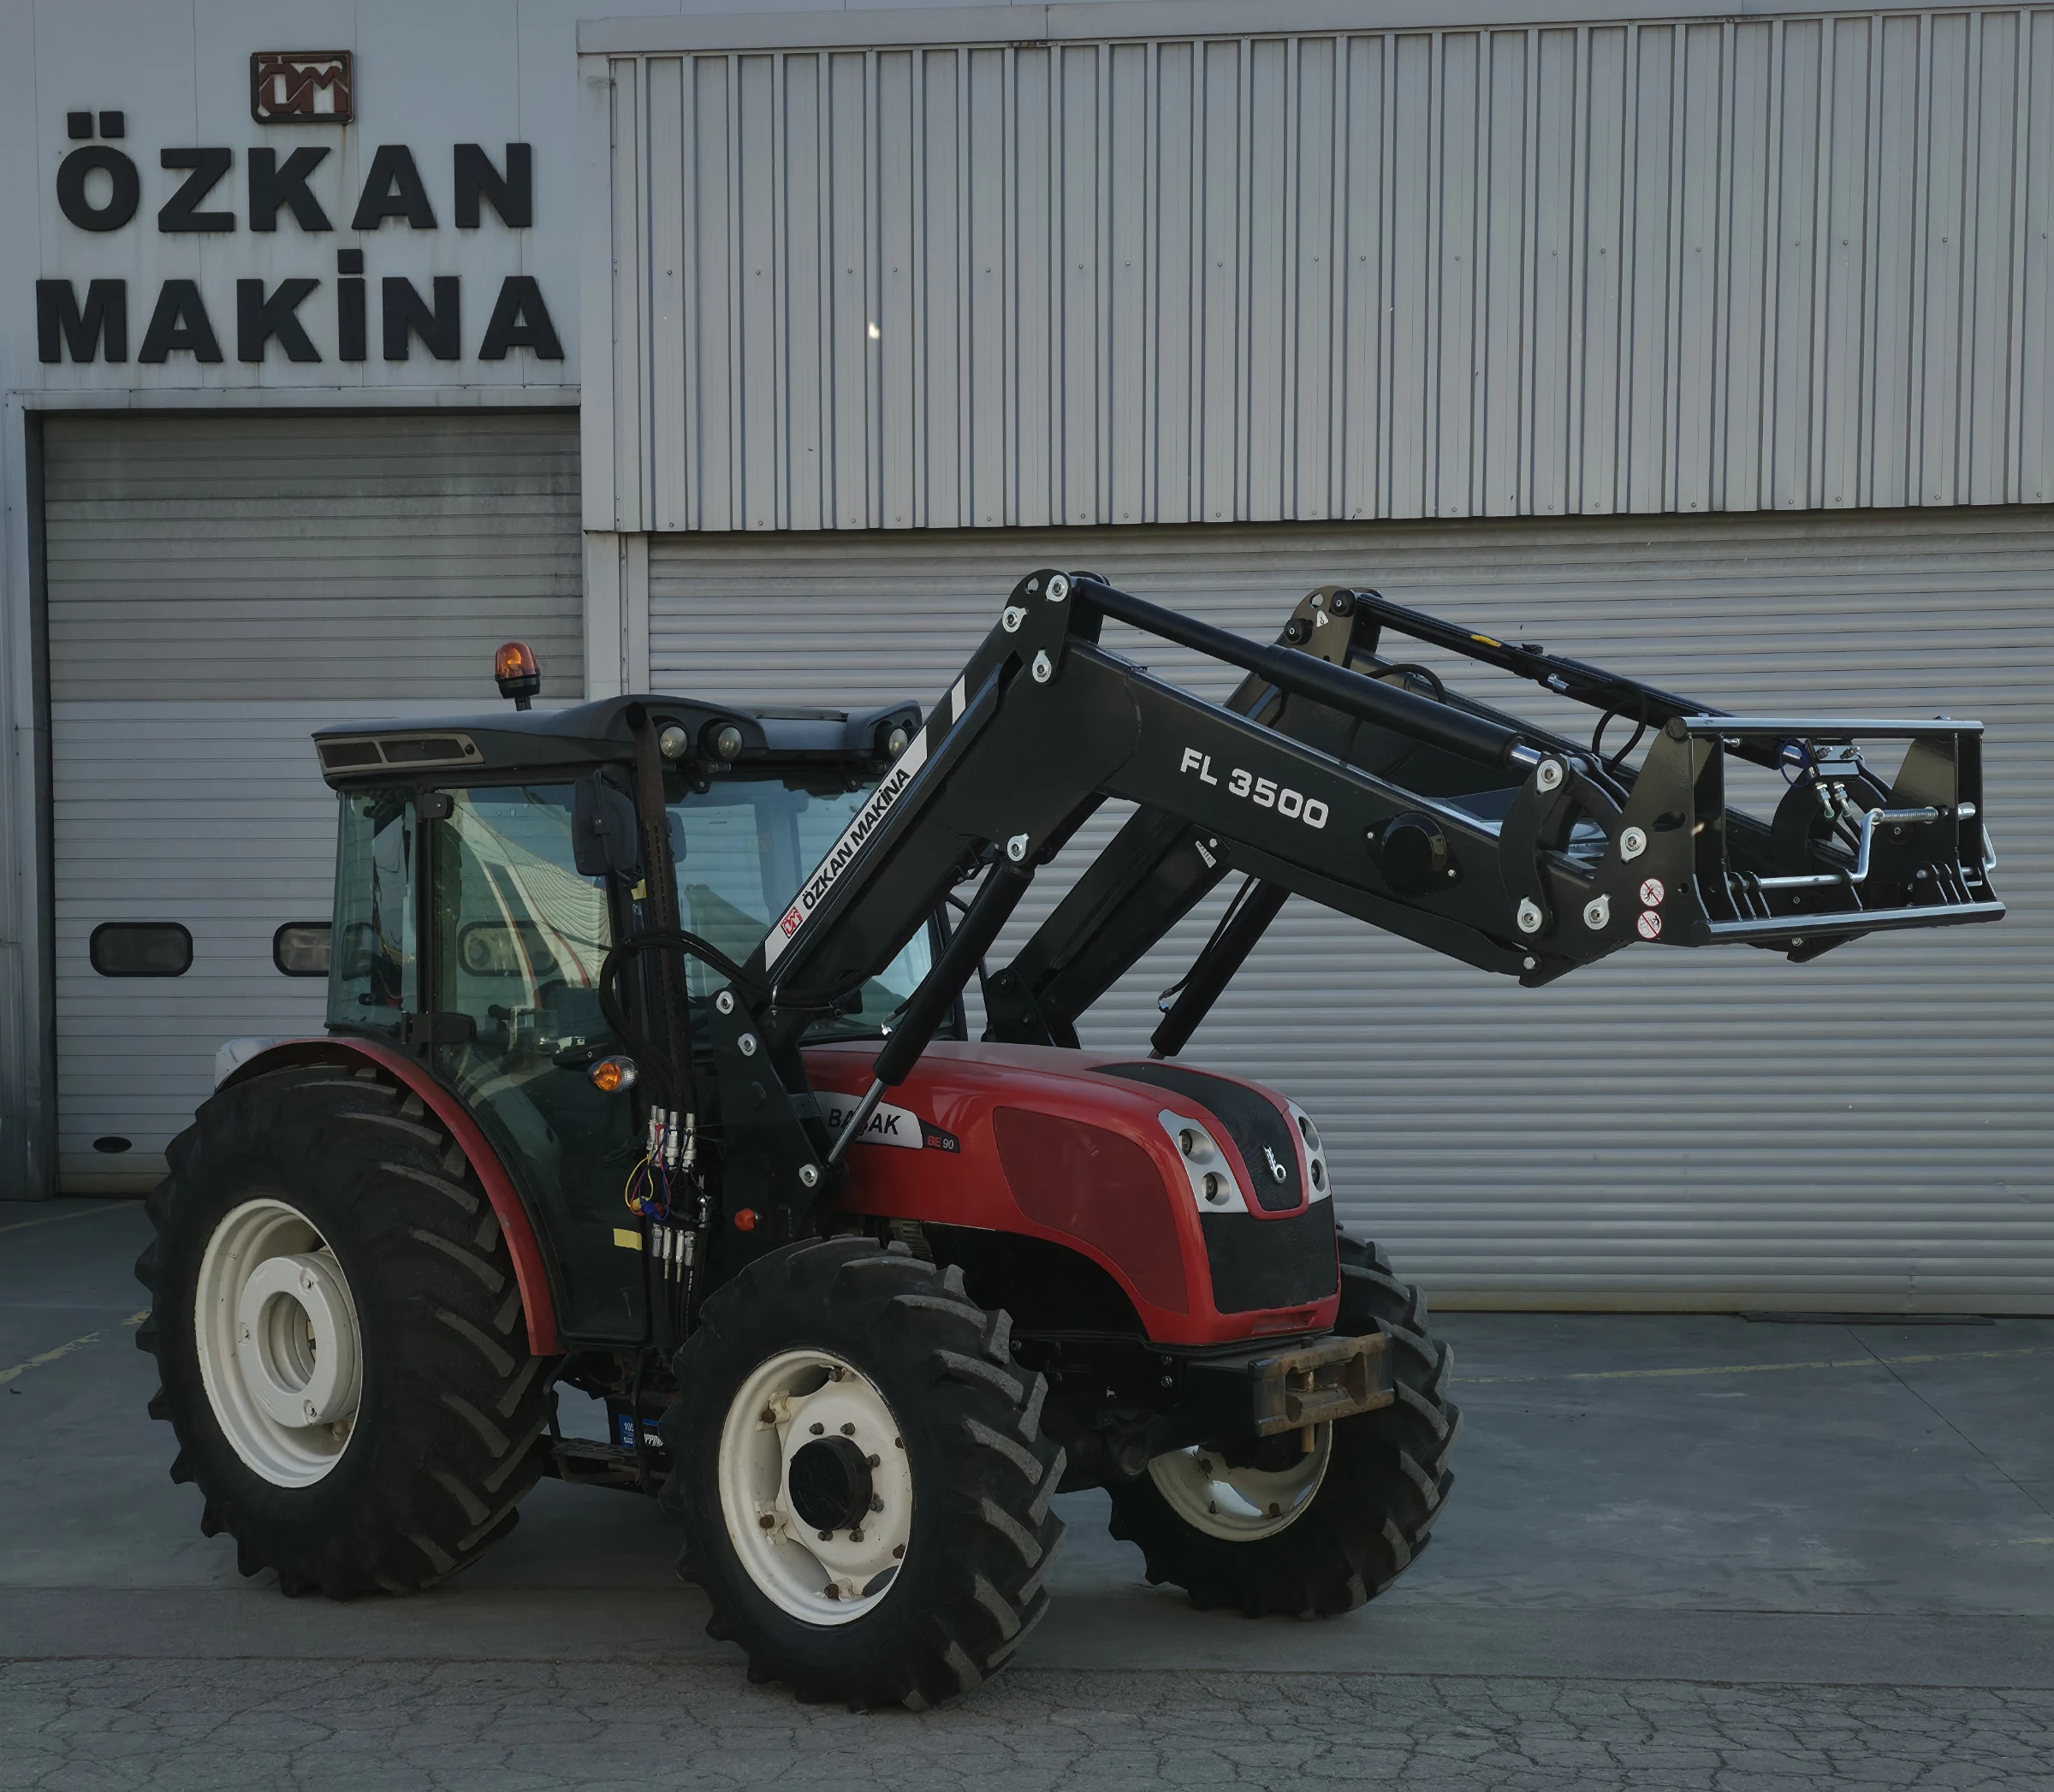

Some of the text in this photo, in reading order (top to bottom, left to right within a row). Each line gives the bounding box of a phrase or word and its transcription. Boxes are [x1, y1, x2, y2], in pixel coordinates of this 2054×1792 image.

[56, 110, 532, 232] ÖZKAN
[36, 248, 565, 363] MAKİNA
[802, 841, 854, 911] ÖZKAN
[850, 768, 911, 847] MAKİNA
[1180, 747, 1329, 829] FL 3500
[927, 1135, 954, 1150] BE 90
